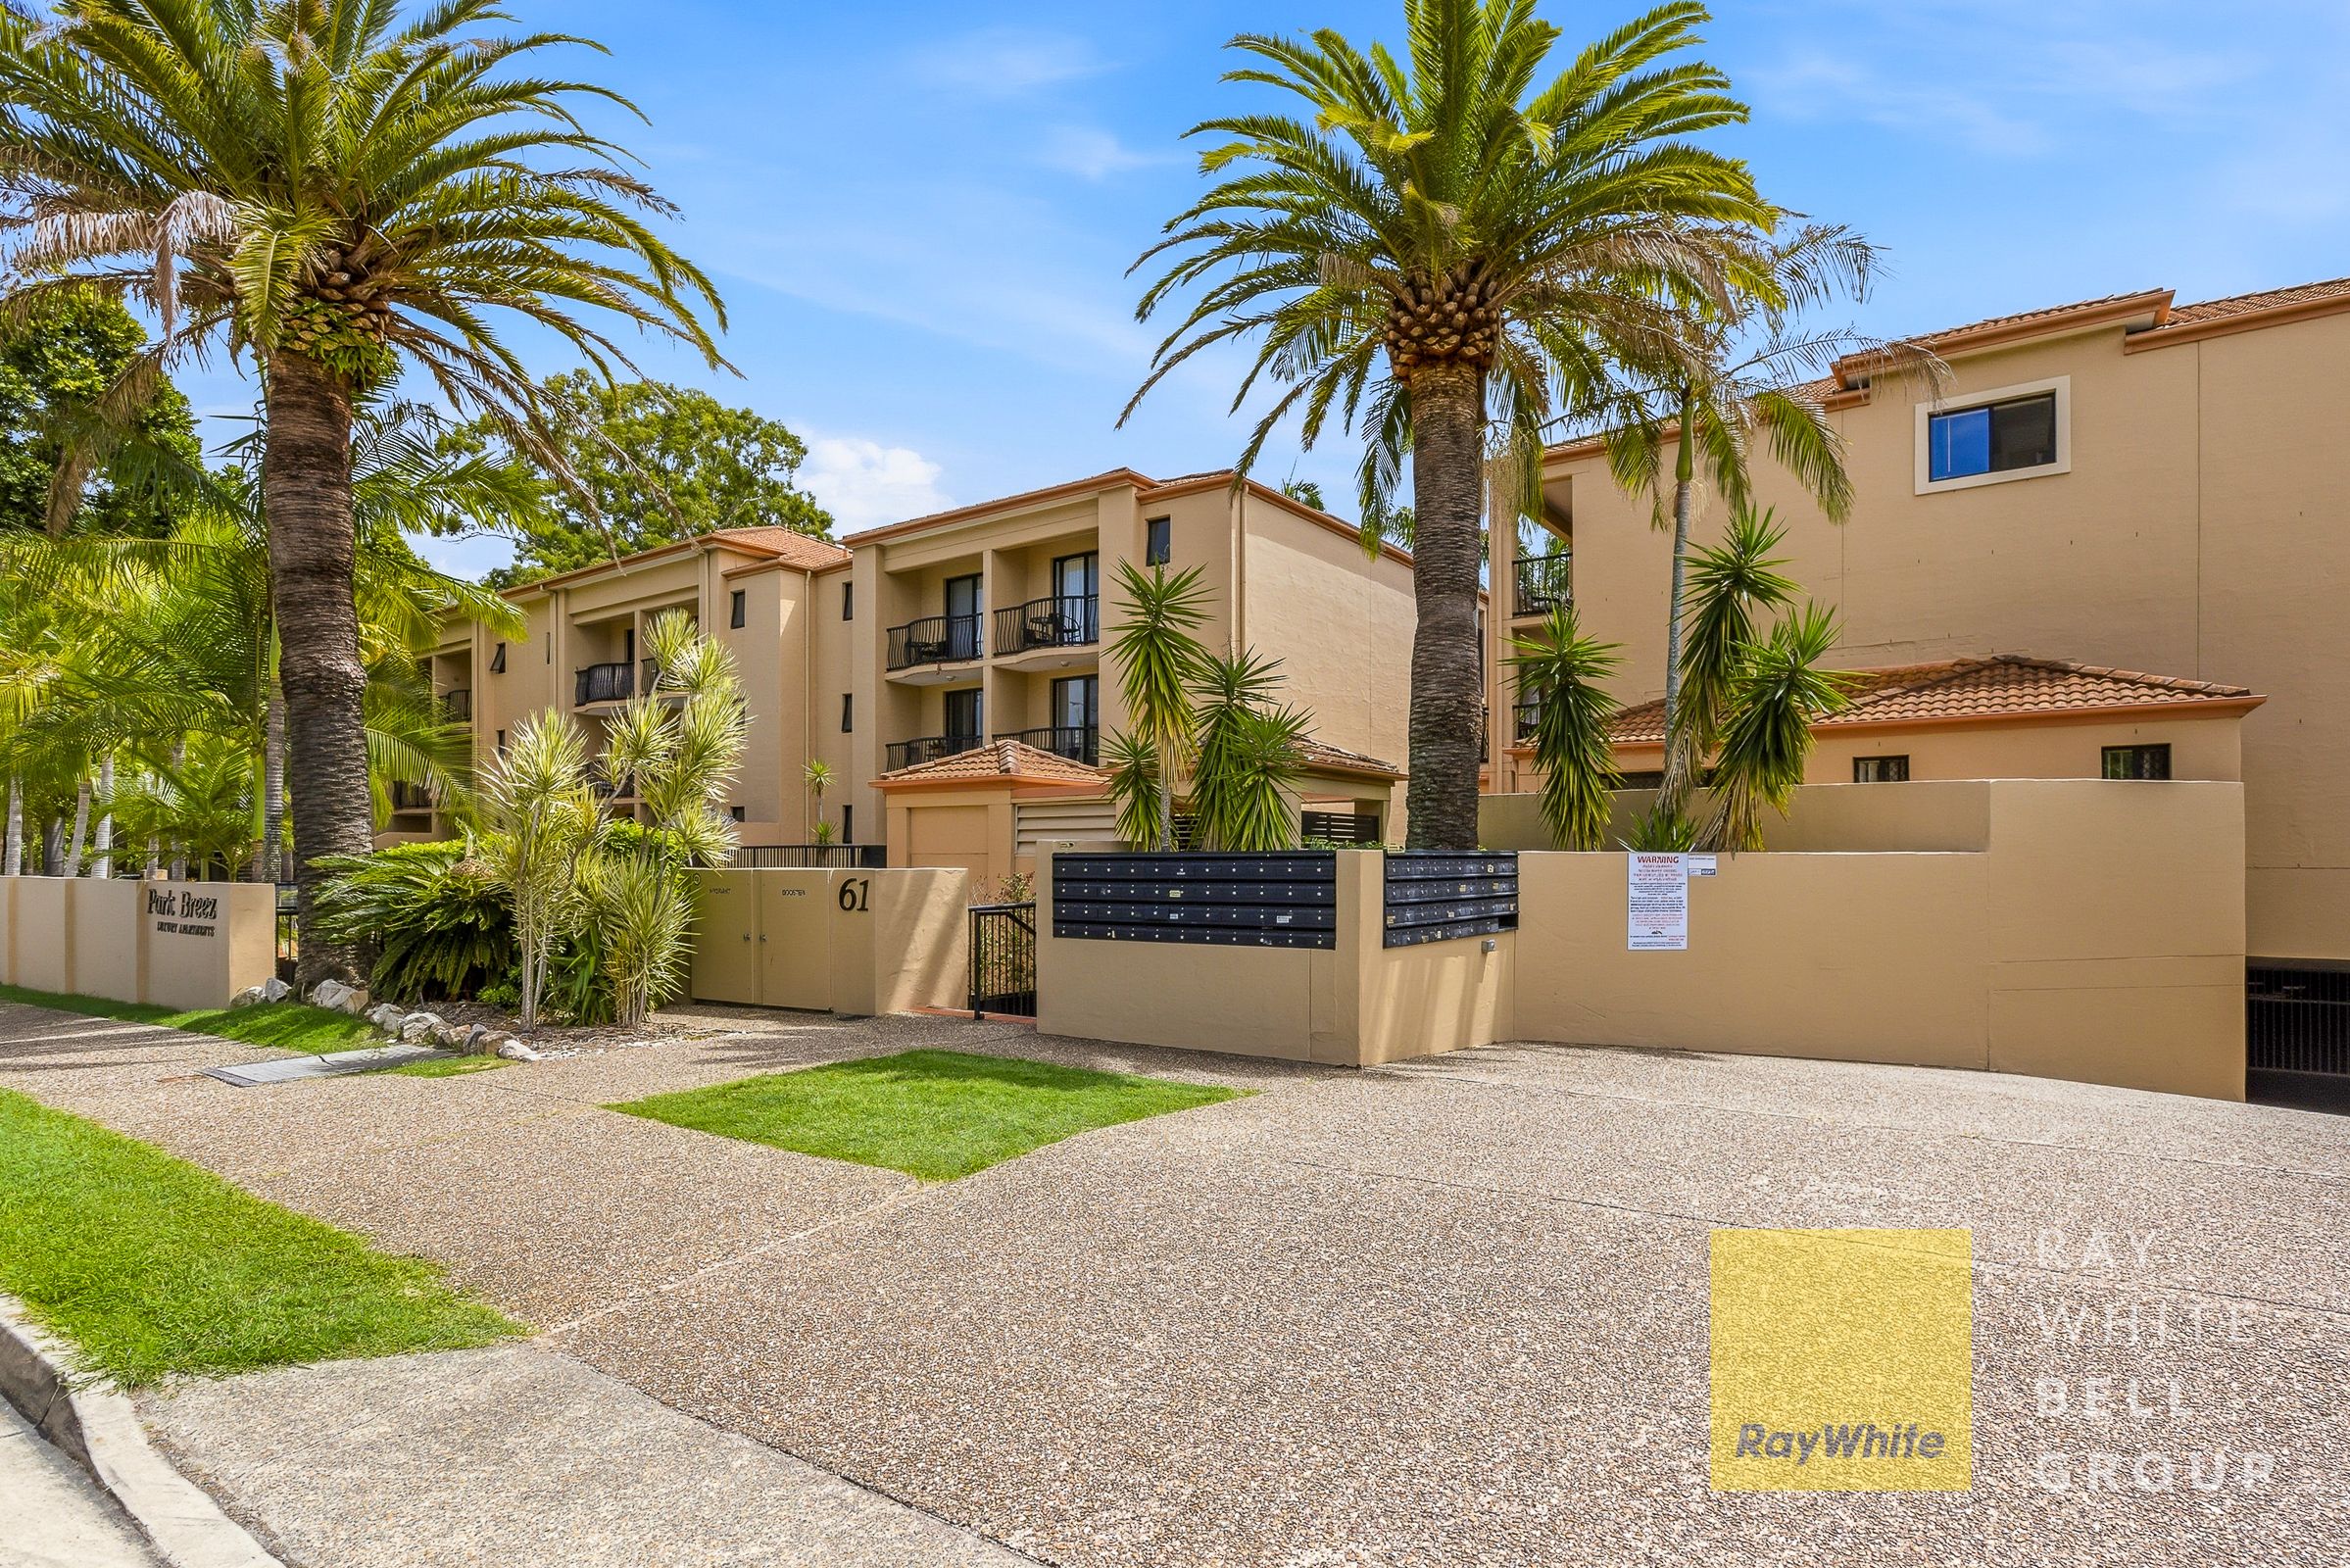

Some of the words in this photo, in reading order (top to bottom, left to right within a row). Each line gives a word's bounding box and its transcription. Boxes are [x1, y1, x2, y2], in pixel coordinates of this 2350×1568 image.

[1637, 856, 1680, 864] WARNING
[147, 888, 175, 916] Park
[838, 877, 869, 912] 61
